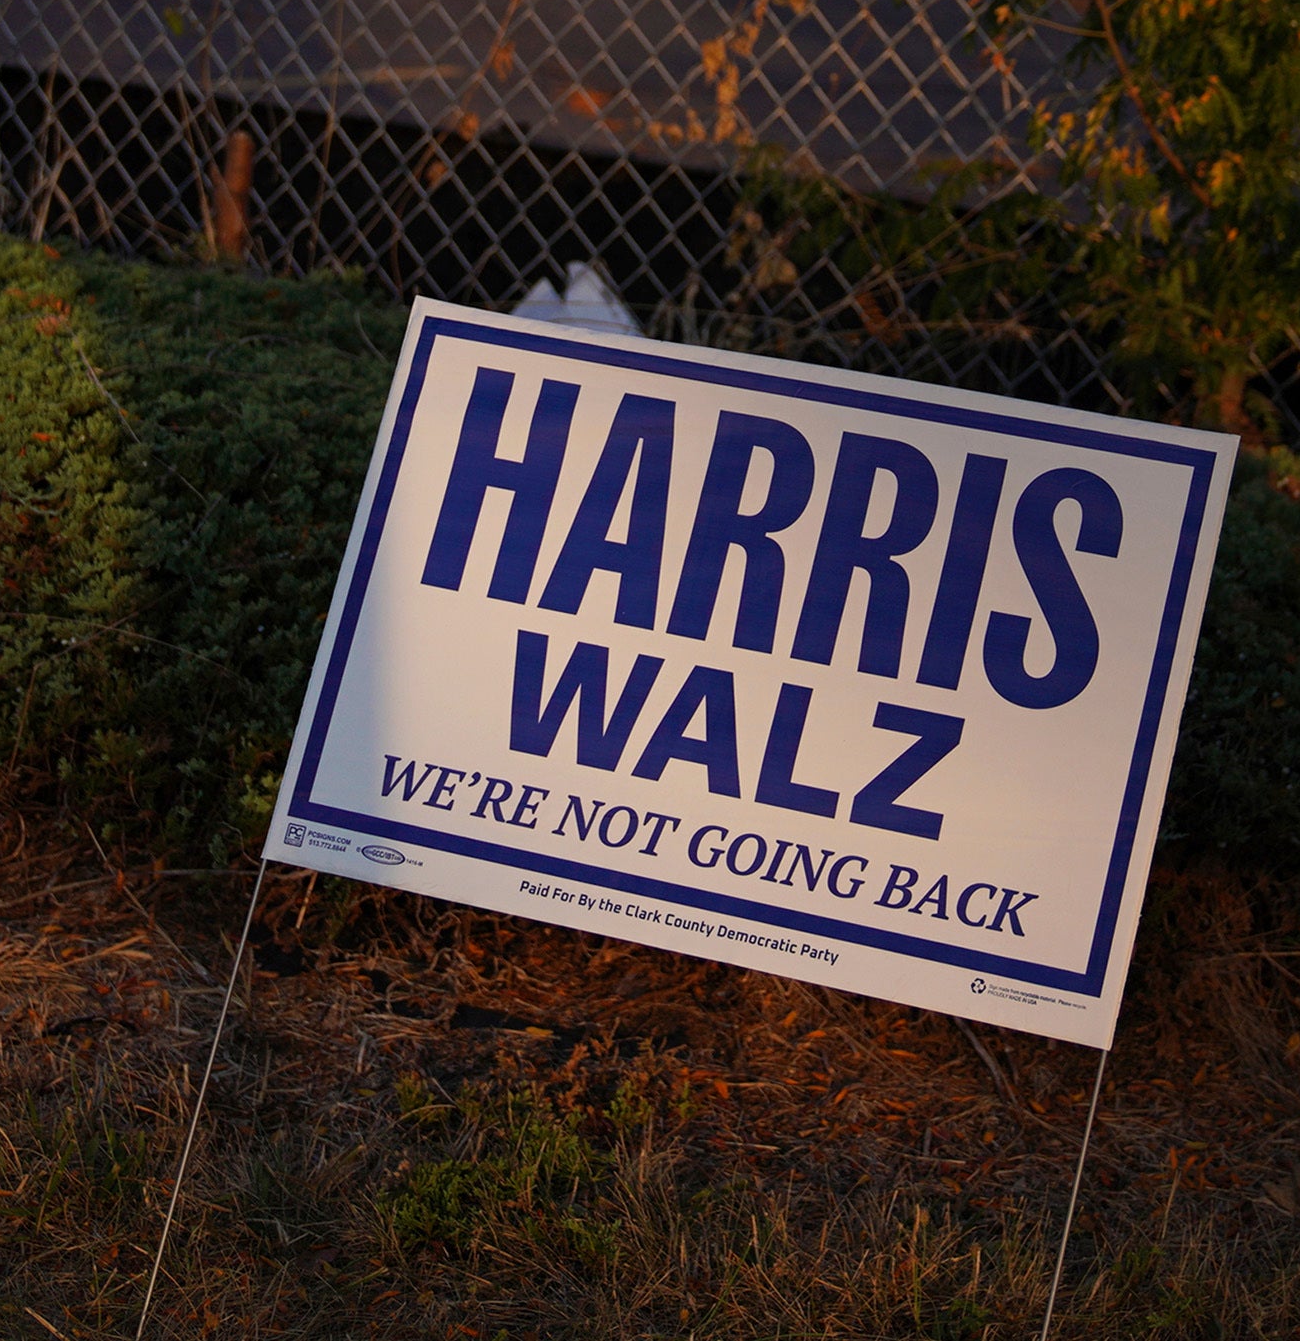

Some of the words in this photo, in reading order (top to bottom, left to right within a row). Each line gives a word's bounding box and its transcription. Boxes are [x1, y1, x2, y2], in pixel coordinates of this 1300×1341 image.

[420, 366, 1124, 710] HARRIS
[508, 630, 965, 841] WALZ
[307, 830, 352, 846] PCSIGNS.COM
[552, 793, 682, 857] NOT
[688, 824, 869, 900] GOING
[873, 863, 1039, 937] BACK
[519, 880, 550, 897] Paid
[552, 888, 576, 904] For
[578, 893, 596, 910] By
[599, 898, 623, 914] the
[625, 904, 662, 924] Clark
[665, 913, 715, 938] County
[717, 925, 798, 954] Democratic
[800, 943, 839, 966] Party
